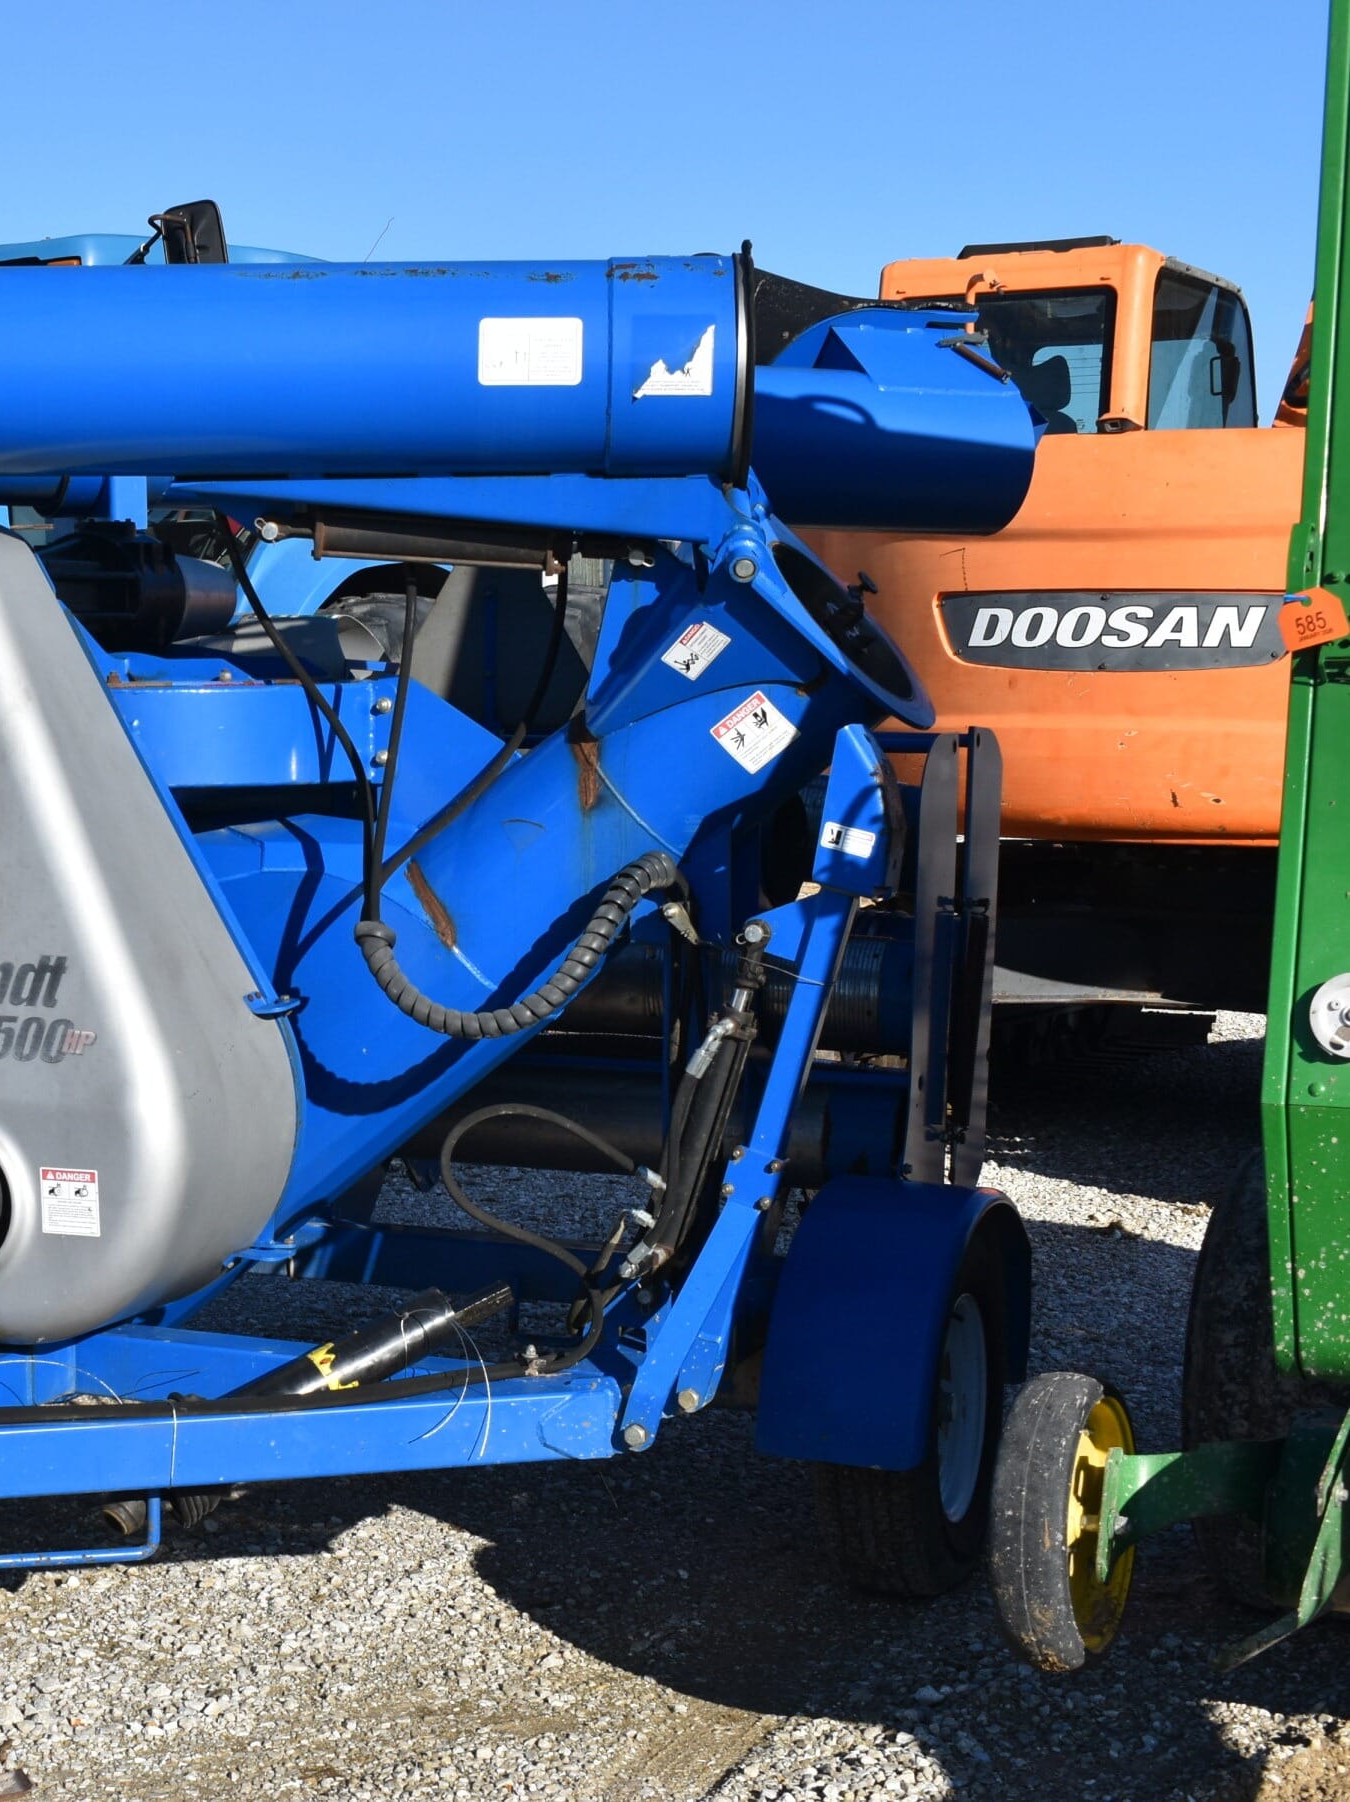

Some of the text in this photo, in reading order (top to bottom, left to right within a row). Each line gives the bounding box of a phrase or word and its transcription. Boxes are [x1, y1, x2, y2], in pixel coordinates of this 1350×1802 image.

[967, 605, 1269, 649] DOOSAN
[1295, 611, 1327, 636] 585
[725, 698, 761, 729] DANGER
[55, 1171, 91, 1182] DANGER
